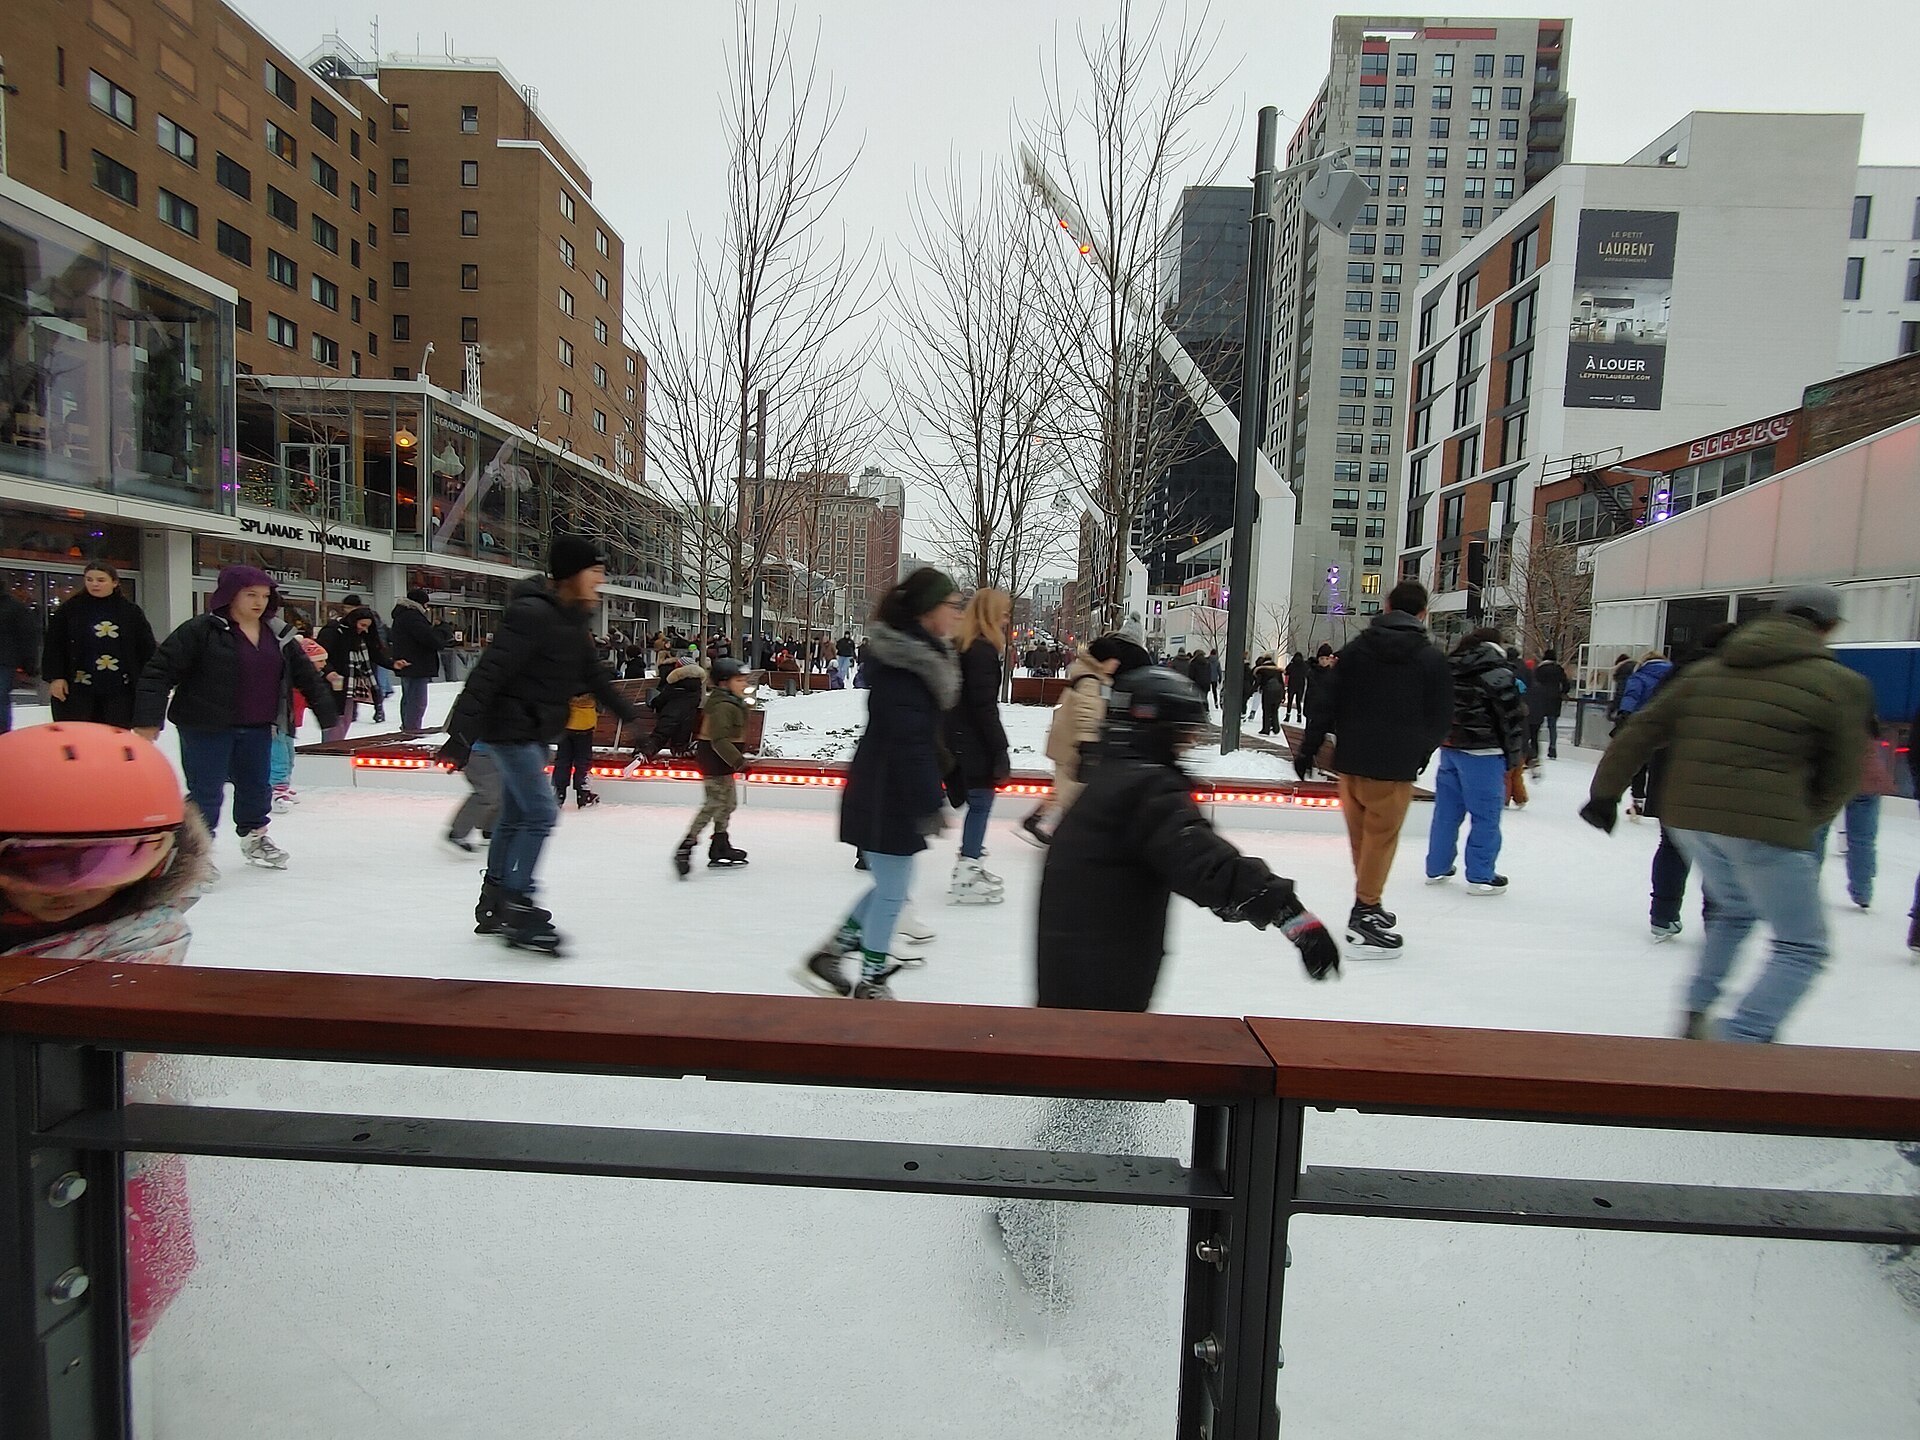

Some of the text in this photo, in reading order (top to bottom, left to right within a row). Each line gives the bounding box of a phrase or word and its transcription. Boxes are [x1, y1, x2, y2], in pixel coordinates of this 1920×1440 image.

[1622, 231, 1643, 239] PETIT
[1598, 241, 1655, 256] LAURENT
[1586, 355, 1645, 371] À LOUER
[1579, 372, 1651, 381] LEPETITLAURENT.COM
[432, 414, 478, 440] LE GRAND SALON
[240, 517, 371, 551] SPLANADE TRANQUILLE
[331, 578, 349, 588] 1442
